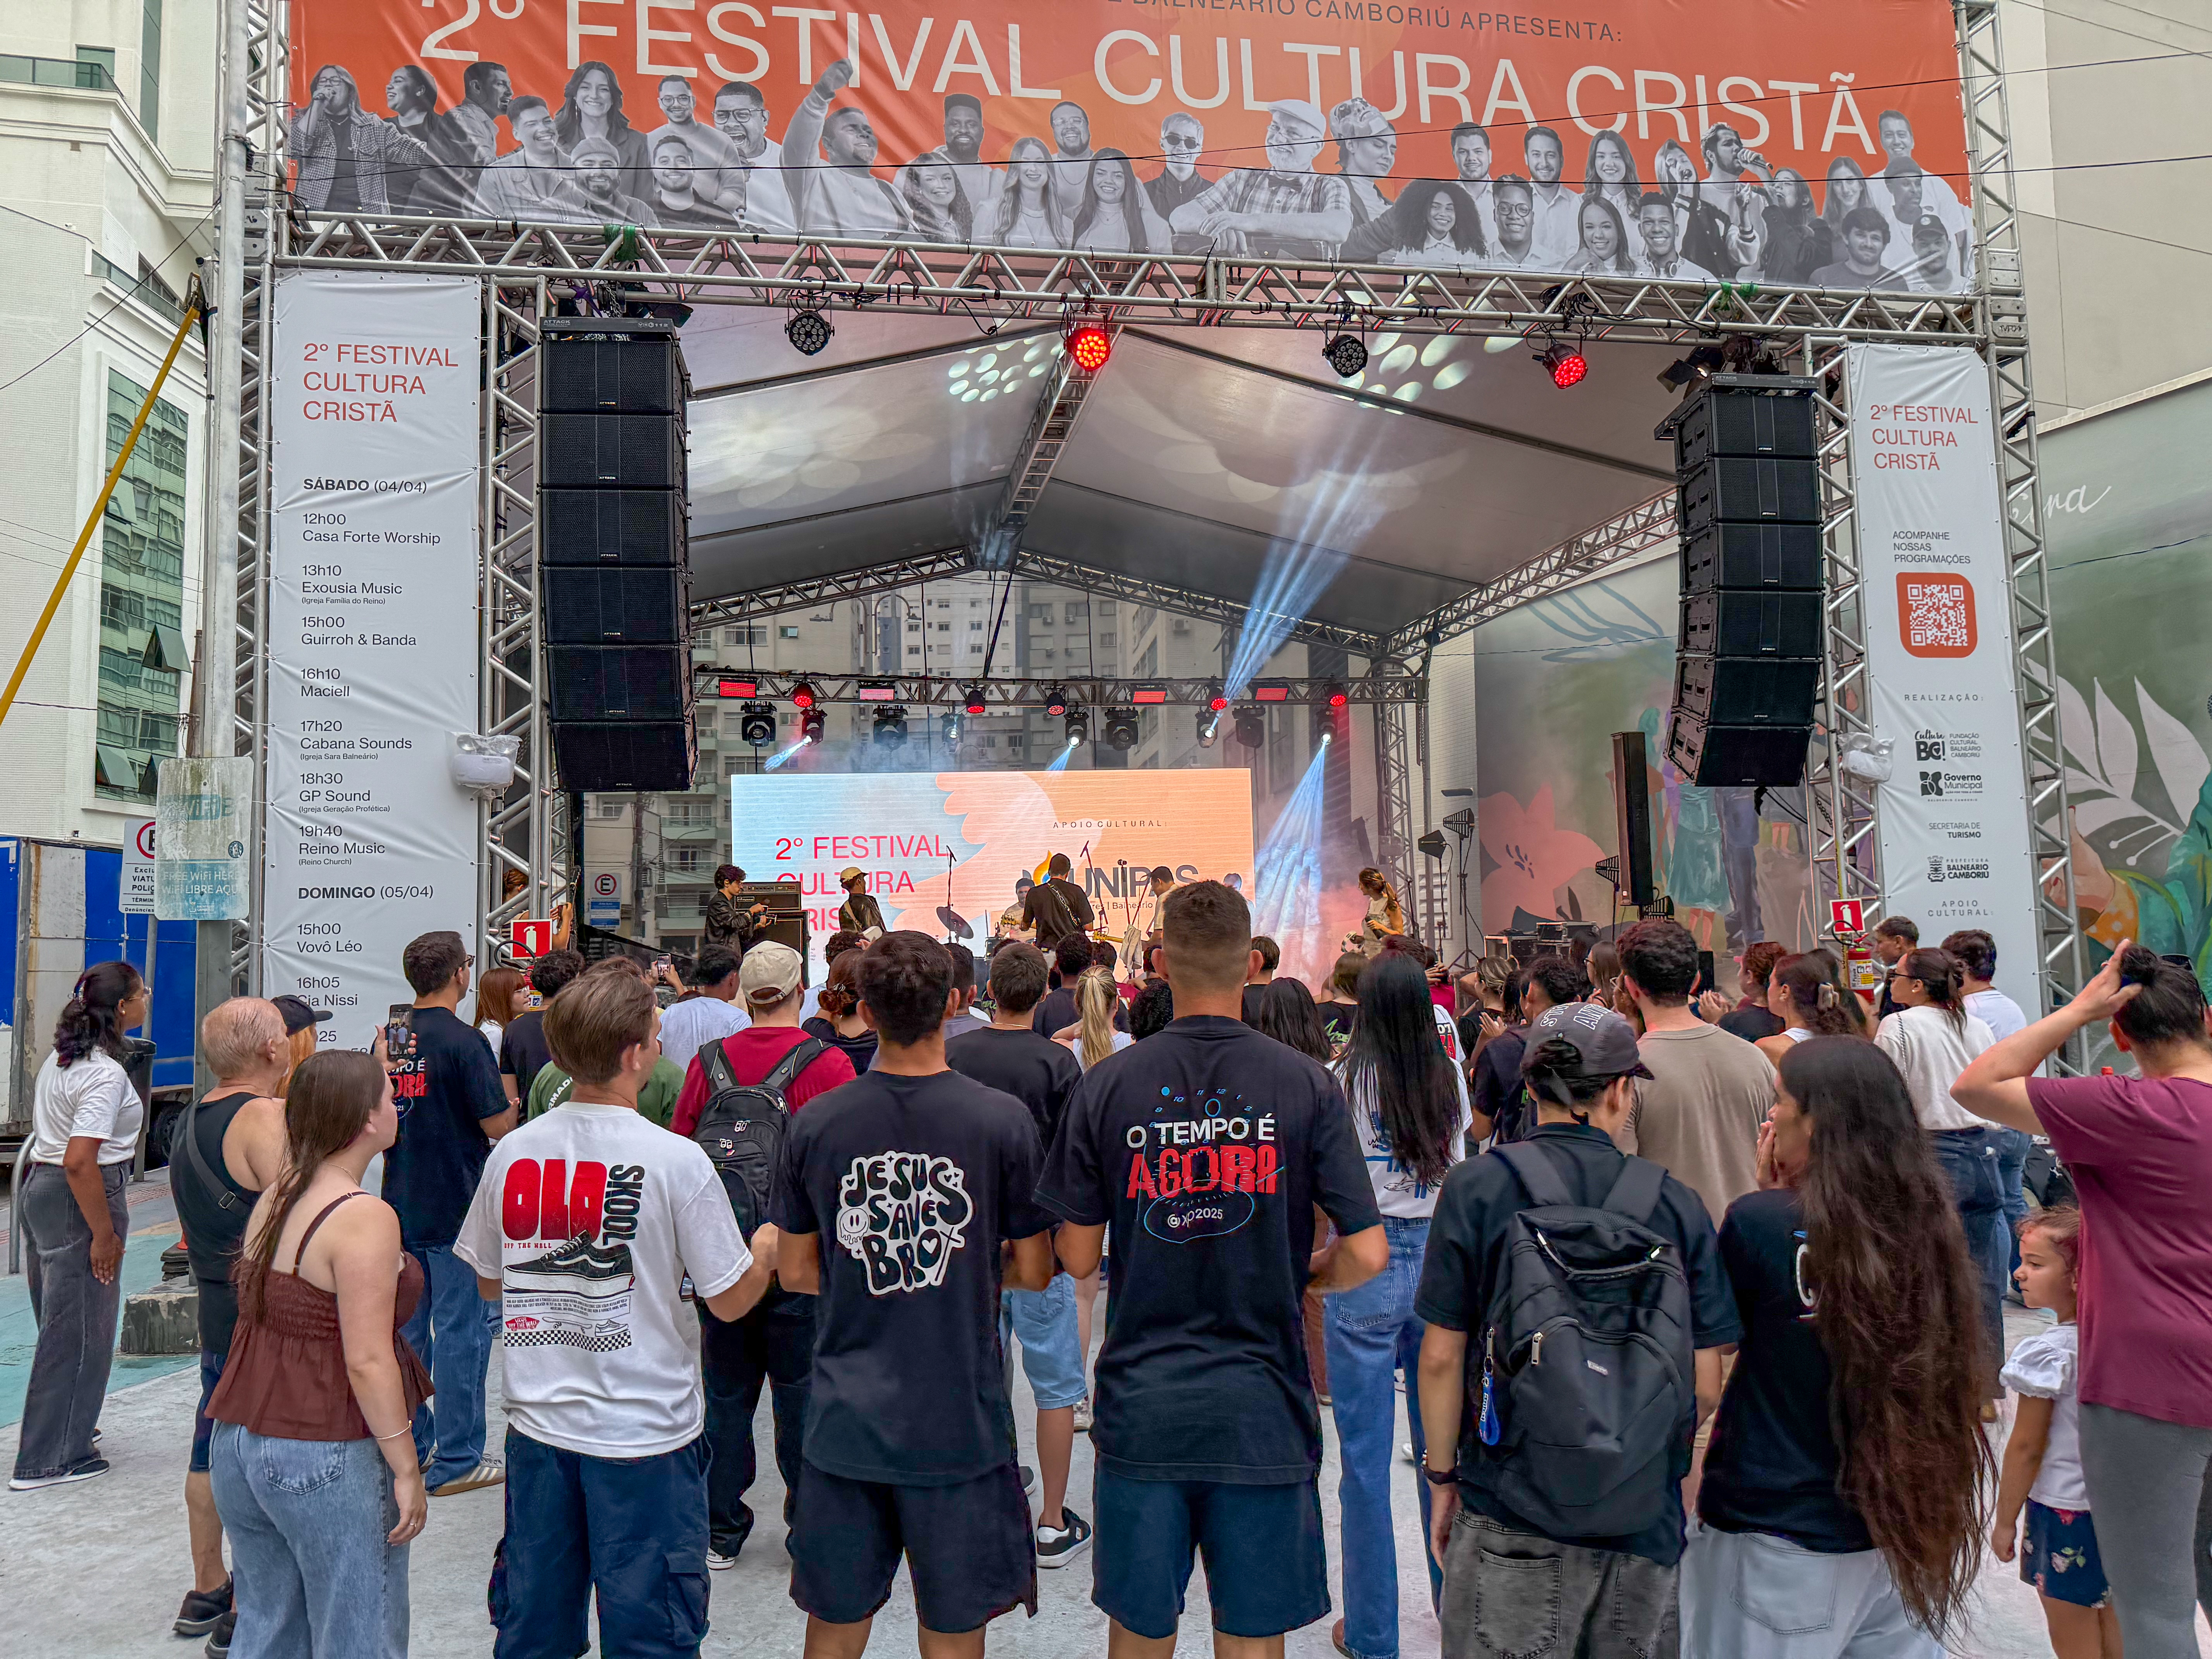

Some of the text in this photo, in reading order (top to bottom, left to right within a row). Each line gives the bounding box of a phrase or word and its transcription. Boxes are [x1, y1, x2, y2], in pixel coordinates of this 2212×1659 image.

[1305, 0, 1449, 28] CAMBORIÚ
[1461, 10, 1621, 42] APRESENTA:
[567, 0, 1061, 99] FESTIVAL
[1094, 29, 1538, 129] CULTURA
[1567, 72, 1877, 155] CRISTÃ
[304, 343, 458, 367] 2º FESTIVAL
[303, 372, 426, 394] CULTURA
[303, 400, 397, 422] CRISTÃ
[1870, 404, 1978, 424] 2º FESTIVAL
[1872, 428, 1958, 447] CULTURA
[1874, 452, 1940, 471] CRISTÃ
[303, 477, 427, 494] SÁBADO (04/04)
[302, 513, 346, 524] 12h00
[302, 530, 440, 546] Casa Forte Worship
[1893, 531, 1950, 540] ACOMPANHE
[1894, 543, 1931, 551] NOSSAS
[1894, 554, 1971, 565] PROGRAMAÇÕES
[302, 565, 342, 576] 13h10
[302, 582, 402, 594] Exousia Music
[301, 617, 345, 627] 15h00
[301, 634, 416, 646] Guirroh & Banda
[301, 668, 340, 679] 16h10
[301, 685, 349, 697] Maciell
[1905, 694, 1984, 702] REALIZAÇÃO:
[300, 721, 342, 732] 17h20
[1915, 729, 1945, 740] Cultura
[300, 738, 412, 749] Cabana Sounds
[300, 773, 343, 784] 18h30
[1944, 781, 1982, 790] Municipal
[299, 790, 371, 802] GP Sound
[299, 826, 342, 836] 19h40
[299, 842, 385, 854] Reino Music
[776, 835, 951, 860] 2º FESTIVAL
[1947, 863, 1989, 871] BALNEÁRIO
[1948, 870, 1989, 879] CAMBORIÚ
[1068, 865, 1199, 898] UNIPS
[186, 885, 213, 894] LIBRE
[298, 885, 433, 899] DOMINGO (05/04)
[1113, 901, 1153, 909] Balneário
[1928, 909, 1993, 917] CULTURAL:
[297, 924, 341, 934] 15h00
[297, 941, 362, 952] Vovô Léo
[297, 977, 340, 988] 16h05
[325, 994, 357, 1006] Nissi
[418, 1057, 425, 1071] É
[1127, 1113, 1275, 1148] O TEMPO É
[1127, 1144, 1277, 1199] AGORA
[845, 1157, 968, 1226] JESUS
[503, 1158, 607, 1241] OLD
[603, 1164, 645, 1246] SKOOL
